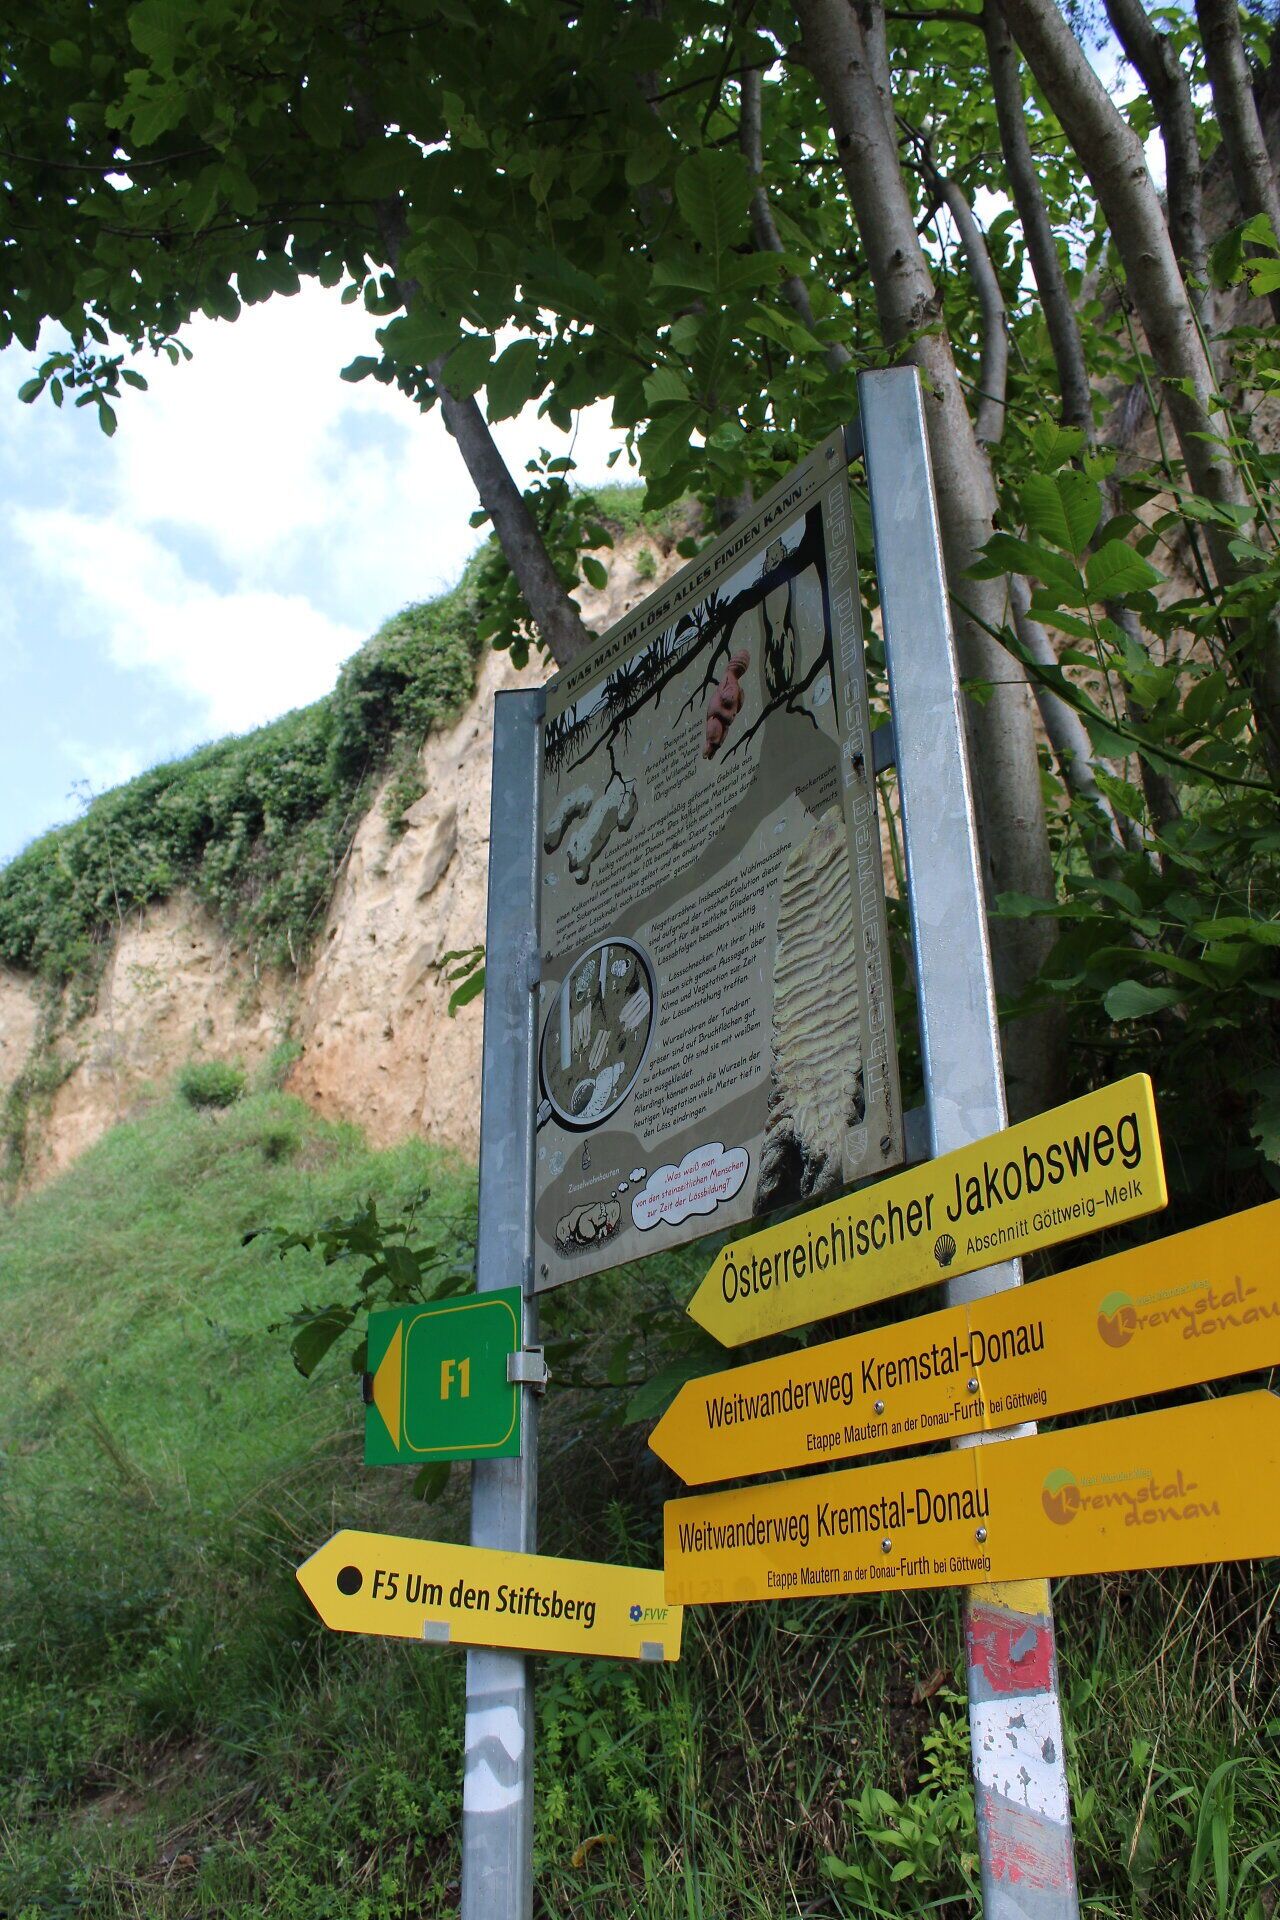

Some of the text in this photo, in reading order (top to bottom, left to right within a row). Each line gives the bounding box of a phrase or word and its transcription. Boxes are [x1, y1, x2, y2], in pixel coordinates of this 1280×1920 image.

[828, 482, 852, 587] Wein
[566, 663, 591, 690] WAS
[593, 640, 620, 669] MAN
[622, 626, 637, 646] IM
[639, 599, 670, 632] LÖSS
[673, 565, 711, 605] ALLES
[713, 522, 760, 571] FINDEN
[763, 485, 802, 527] KANN
[833, 590, 857, 672] und
[818, 777, 837, 794] eines
[648, 932, 661, 947] sind
[661, 915, 690, 939] aufgrund
[690, 910, 702, 922] der
[702, 894, 728, 914] raschen
[729, 875, 760, 898] Evolution
[761, 860, 782, 878] dieser
[653, 877, 778, 955] Tierart für die zeitliche Gliederung von
[697, 875, 738, 905] Insbesondere
[657, 939, 697, 966] Lössabfolgen
[698, 920, 729, 942] besonders
[729, 932, 747, 947] ihrer
[748, 920, 765, 936] Hilfe
[852, 792, 888, 1103] Themenweg
[660, 984, 679, 999] lassen
[680, 975, 693, 989] sich
[693, 964, 717, 984] genaue
[717, 945, 749, 967] Aussagen
[750, 935, 766, 949] über
[660, 953, 757, 1012] Klima und Vegetation zur Zeit
[659, 1015, 671, 1026] der
[672, 989, 721, 1019] Lössentstehung
[661, 1020, 706, 1047] Wurzelröhren
[706, 1013, 719, 1024] der
[642, 1075, 650, 1084] zu
[681, 1052, 694, 1065] Oft
[695, 1044, 709, 1059] sind
[709, 1041, 719, 1052] sie
[720, 1033, 732, 1045] mit
[733, 1021, 761, 1039] weißem
[648, 1052, 670, 1071] gräser
[671, 1042, 685, 1057] sind
[684, 1036, 697, 1050] auf
[698, 1016, 742, 1043] Bruchflächen
[743, 1007, 756, 1023] gut
[632, 1064, 761, 1128] heutigen Vegetation viele Meter tief in
[633, 1050, 761, 1116] Allerdings können auch die Wurzeln der
[633, 1087, 652, 1101] Kalzit
[642, 1128, 655, 1138] den
[655, 1120, 671, 1132] Löss
[634, 1160, 744, 1208] von den steinzeitlichen Menschen
[682, 1160, 699, 1176] weiß
[700, 1157, 715, 1167] man
[646, 1208, 658, 1218] zur
[659, 1201, 673, 1213] Zeit
[673, 1196, 686, 1208] der
[722, 1112, 1142, 1303] Österreichischer Jakobsweg
[966, 1219, 1029, 1255] Abschnitt
[441, 1357, 470, 1400] F1
[706, 1321, 1044, 1429] Weitwanderweg Kremstal-Donau
[807, 1388, 1047, 1451] Etappe Mautern an der Donau-Furth bei Göttweig
[679, 1488, 989, 1553] Weitwanderweg Kremstal-Donau
[372, 1570, 596, 1629] F5 Um den Stiftsberg
[767, 1554, 991, 1589] Etappe Mautern an der Donau-Furth bei Göttweig
[644, 1608, 668, 1621] FVVF
